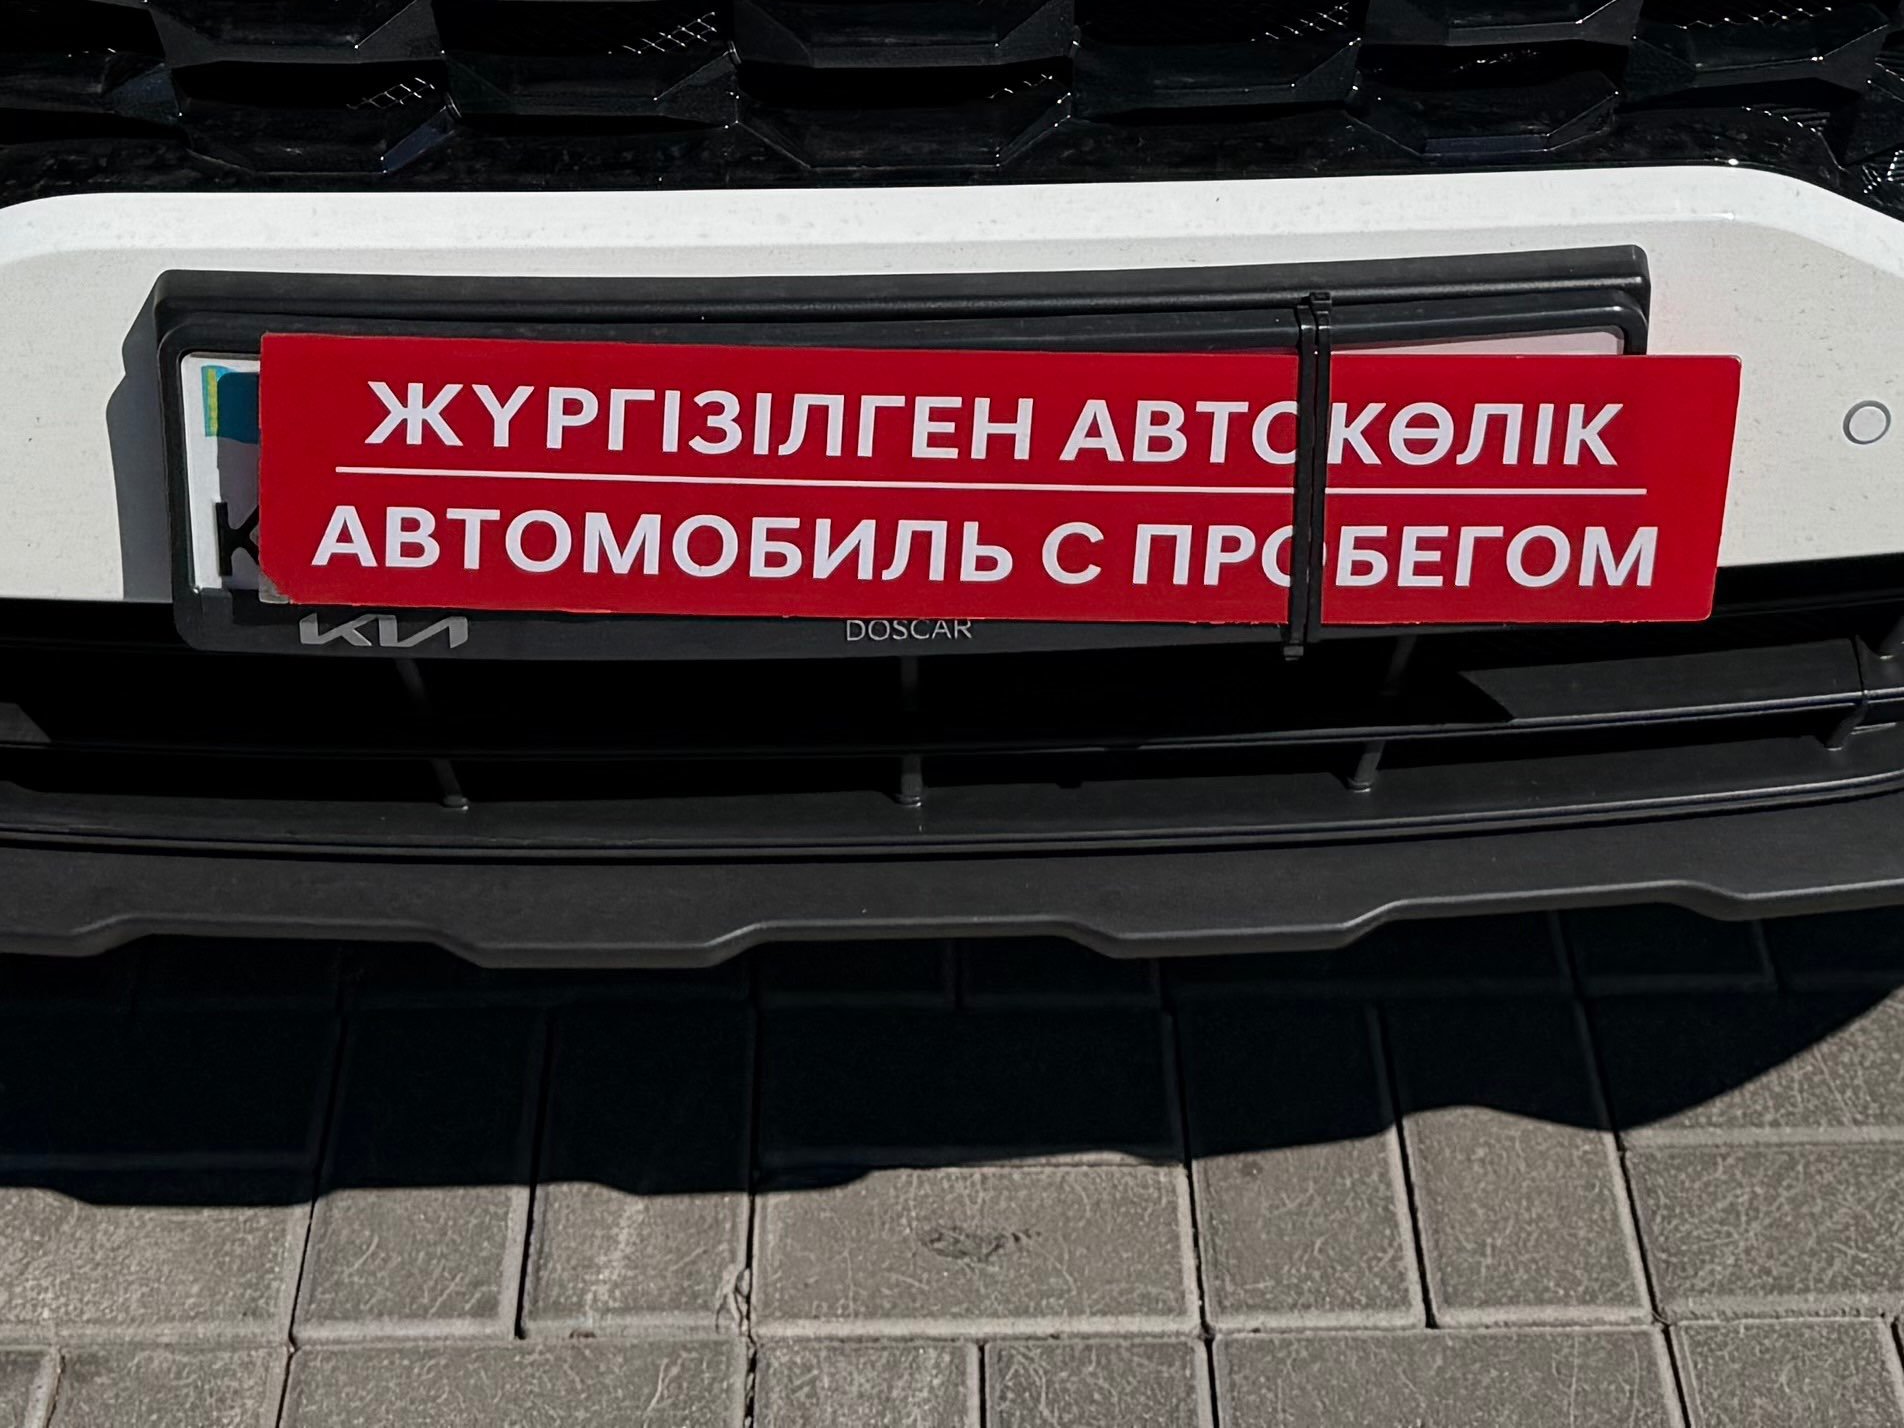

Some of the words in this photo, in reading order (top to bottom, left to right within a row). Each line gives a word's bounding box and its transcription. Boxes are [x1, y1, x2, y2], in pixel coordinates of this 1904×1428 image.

[364, 380, 1035, 461] ЖҮРГІЗІЛГЕН
[310, 504, 1014, 582] АВТОМОБИЛЬ
[846, 619, 973, 642] DOSCAR
